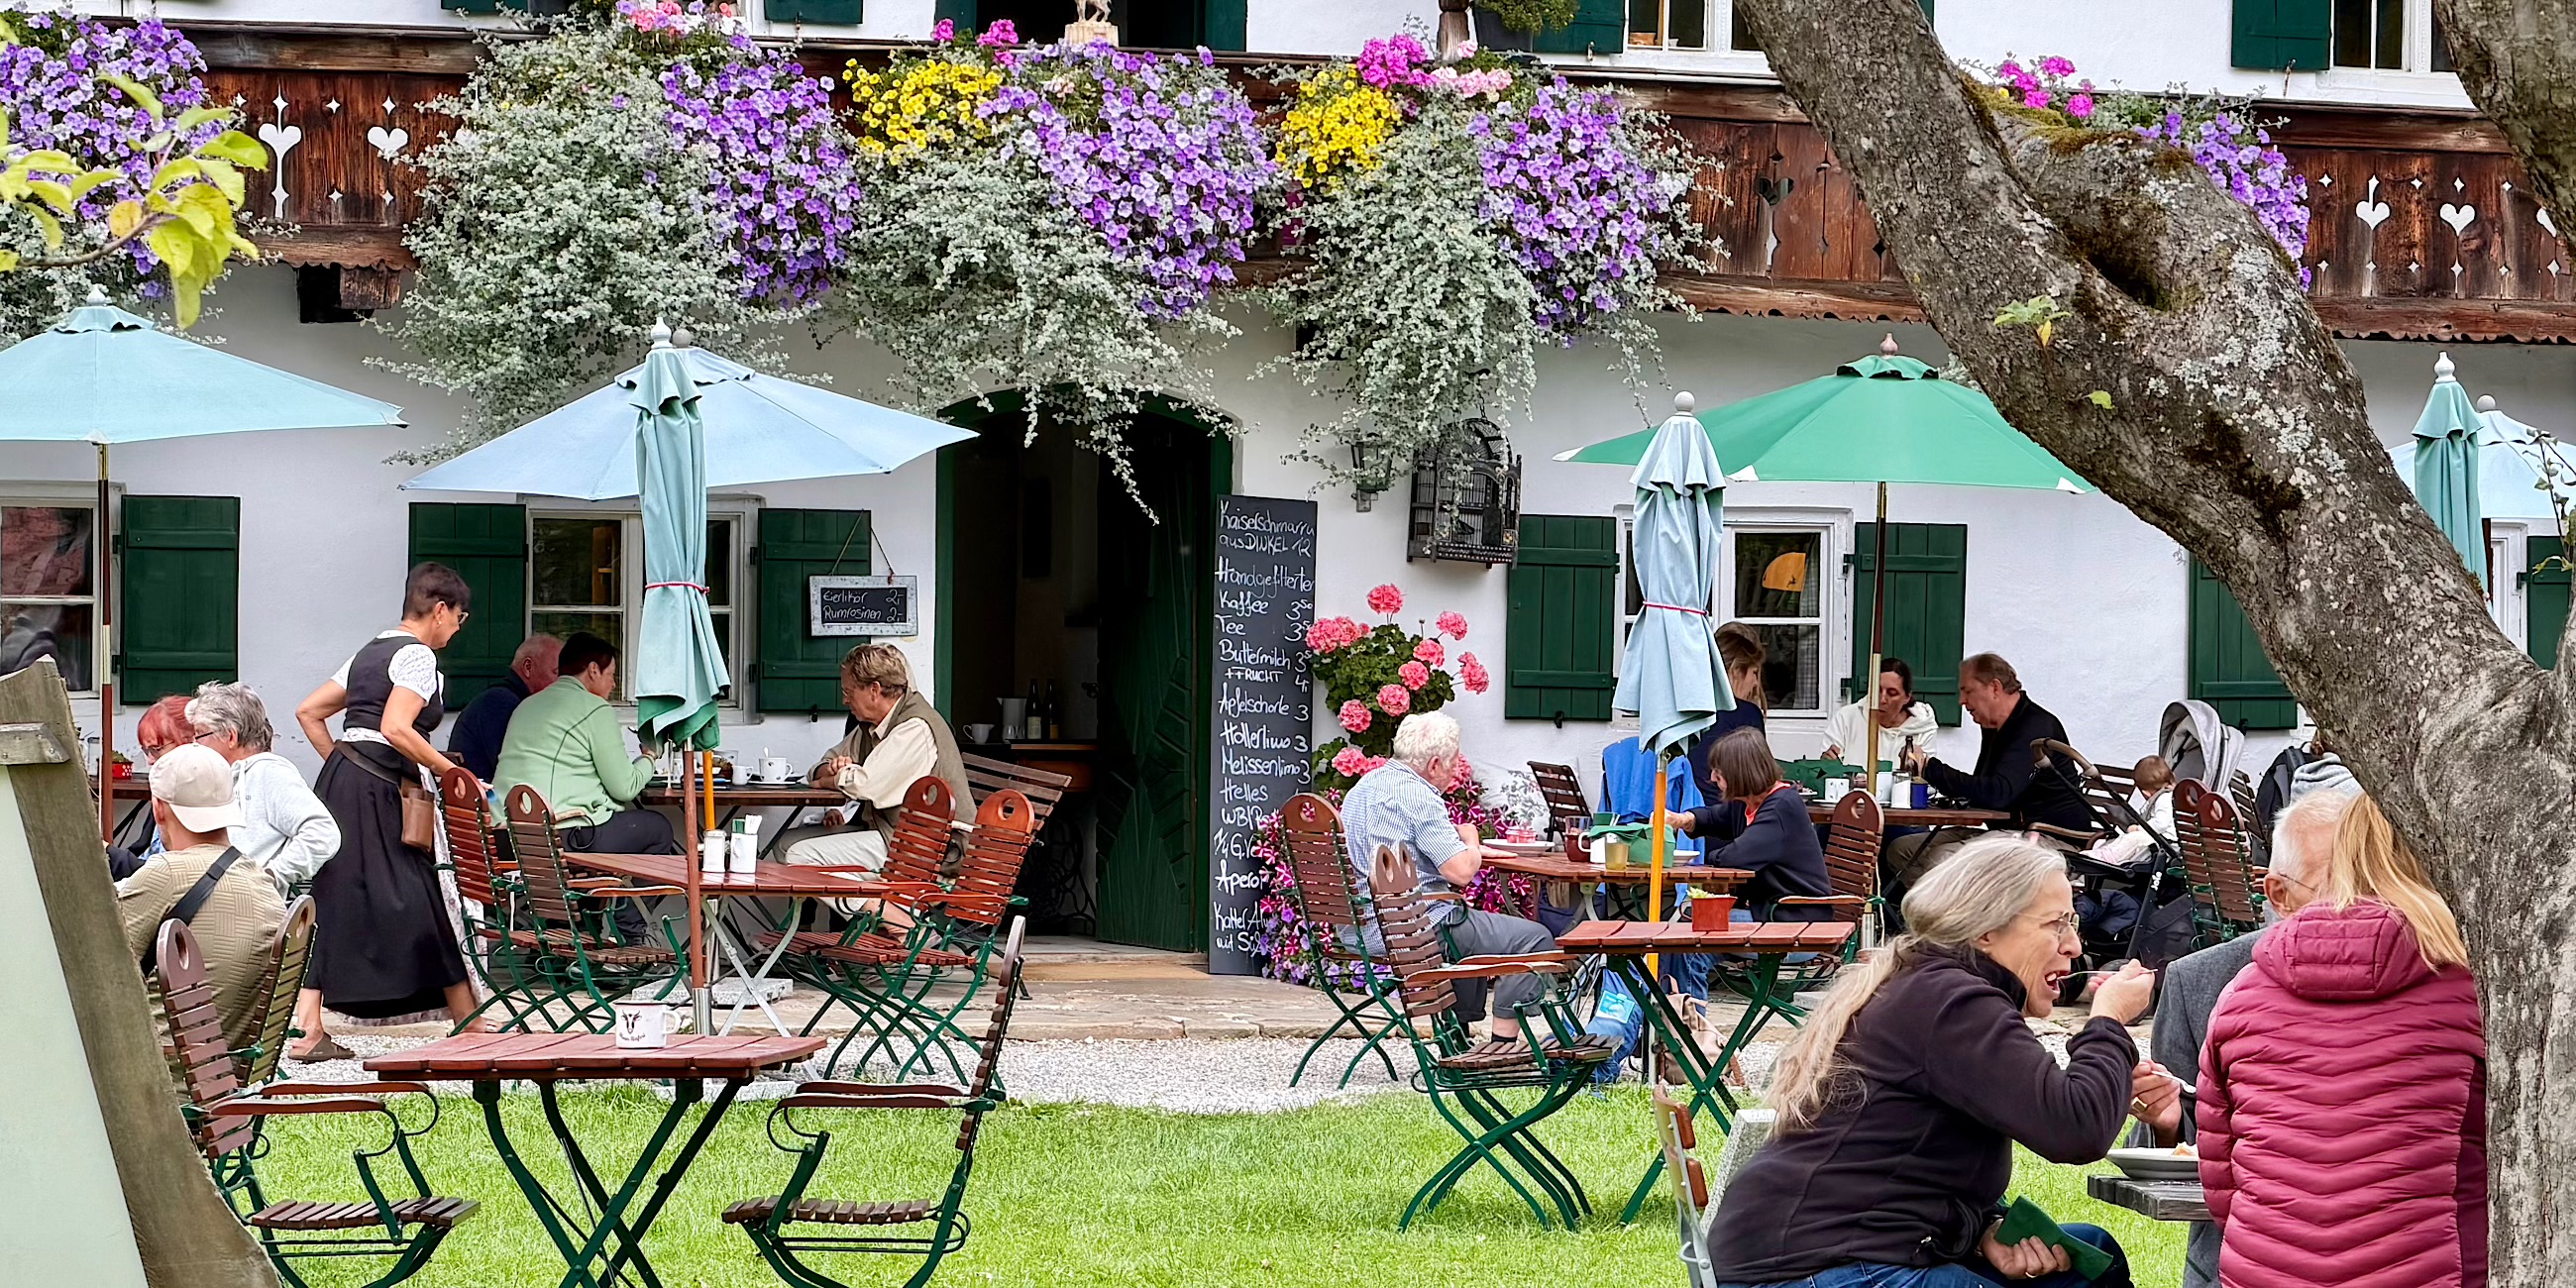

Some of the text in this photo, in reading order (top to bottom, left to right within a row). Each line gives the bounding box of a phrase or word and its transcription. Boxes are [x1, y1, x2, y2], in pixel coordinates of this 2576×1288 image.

[1219, 534, 1245, 550] aus
[1244, 532, 1289, 556] DINKEL
[1215, 555, 1315, 598] Handgefilterter
[823, 604, 882, 620] Rumrosinen
[1219, 589, 1269, 617] Kaffee
[1215, 613, 1246, 635] Tee
[1219, 638, 1291, 671] Buttermilch
[1218, 682, 1309, 721] Apfelschorle 3
[1220, 719, 1309, 753] Hollerlimo 3
[1222, 744, 1311, 785] Melissenlimo 3
[1220, 776, 1268, 805] Helles
